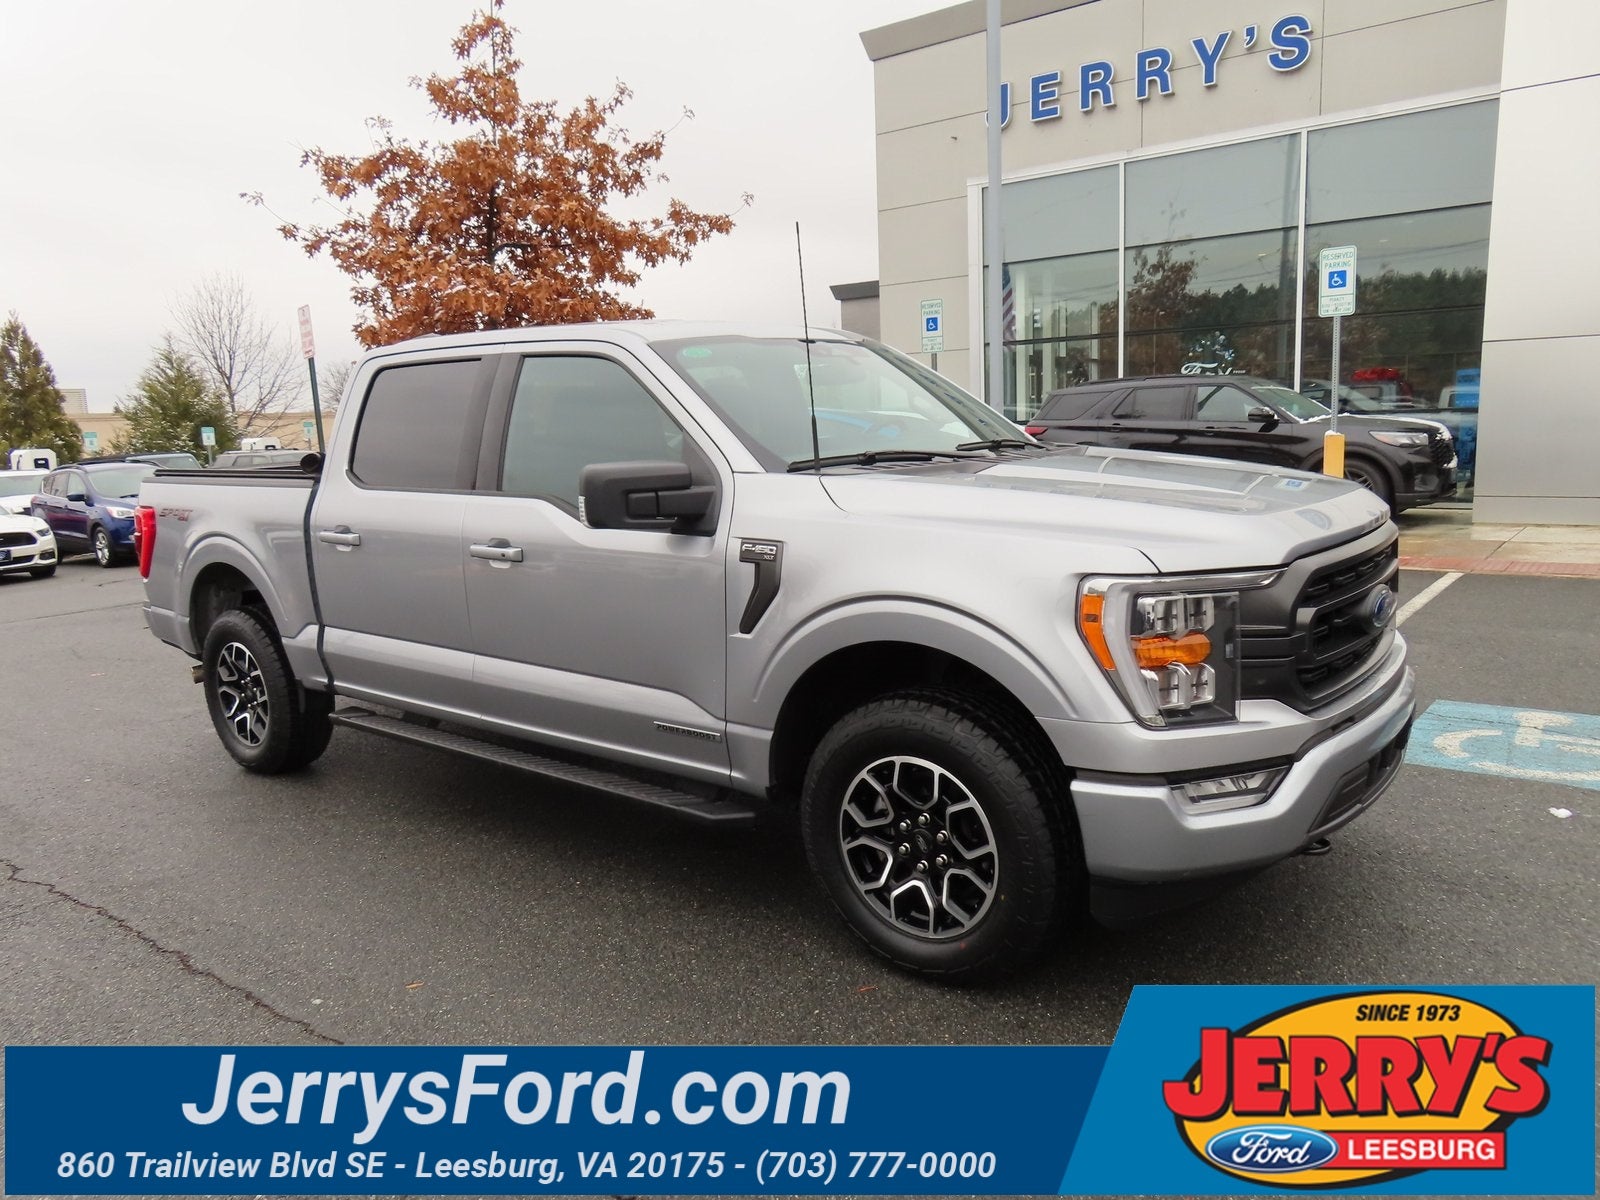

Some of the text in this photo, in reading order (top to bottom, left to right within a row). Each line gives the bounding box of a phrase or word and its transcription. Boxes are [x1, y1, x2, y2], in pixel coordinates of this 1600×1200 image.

[986, 15, 1312, 129] JERRY'S
[1322, 252, 1353, 260] RESERVED
[1325, 260, 1351, 268] PARKING
[742, 544, 777, 554] F-150
